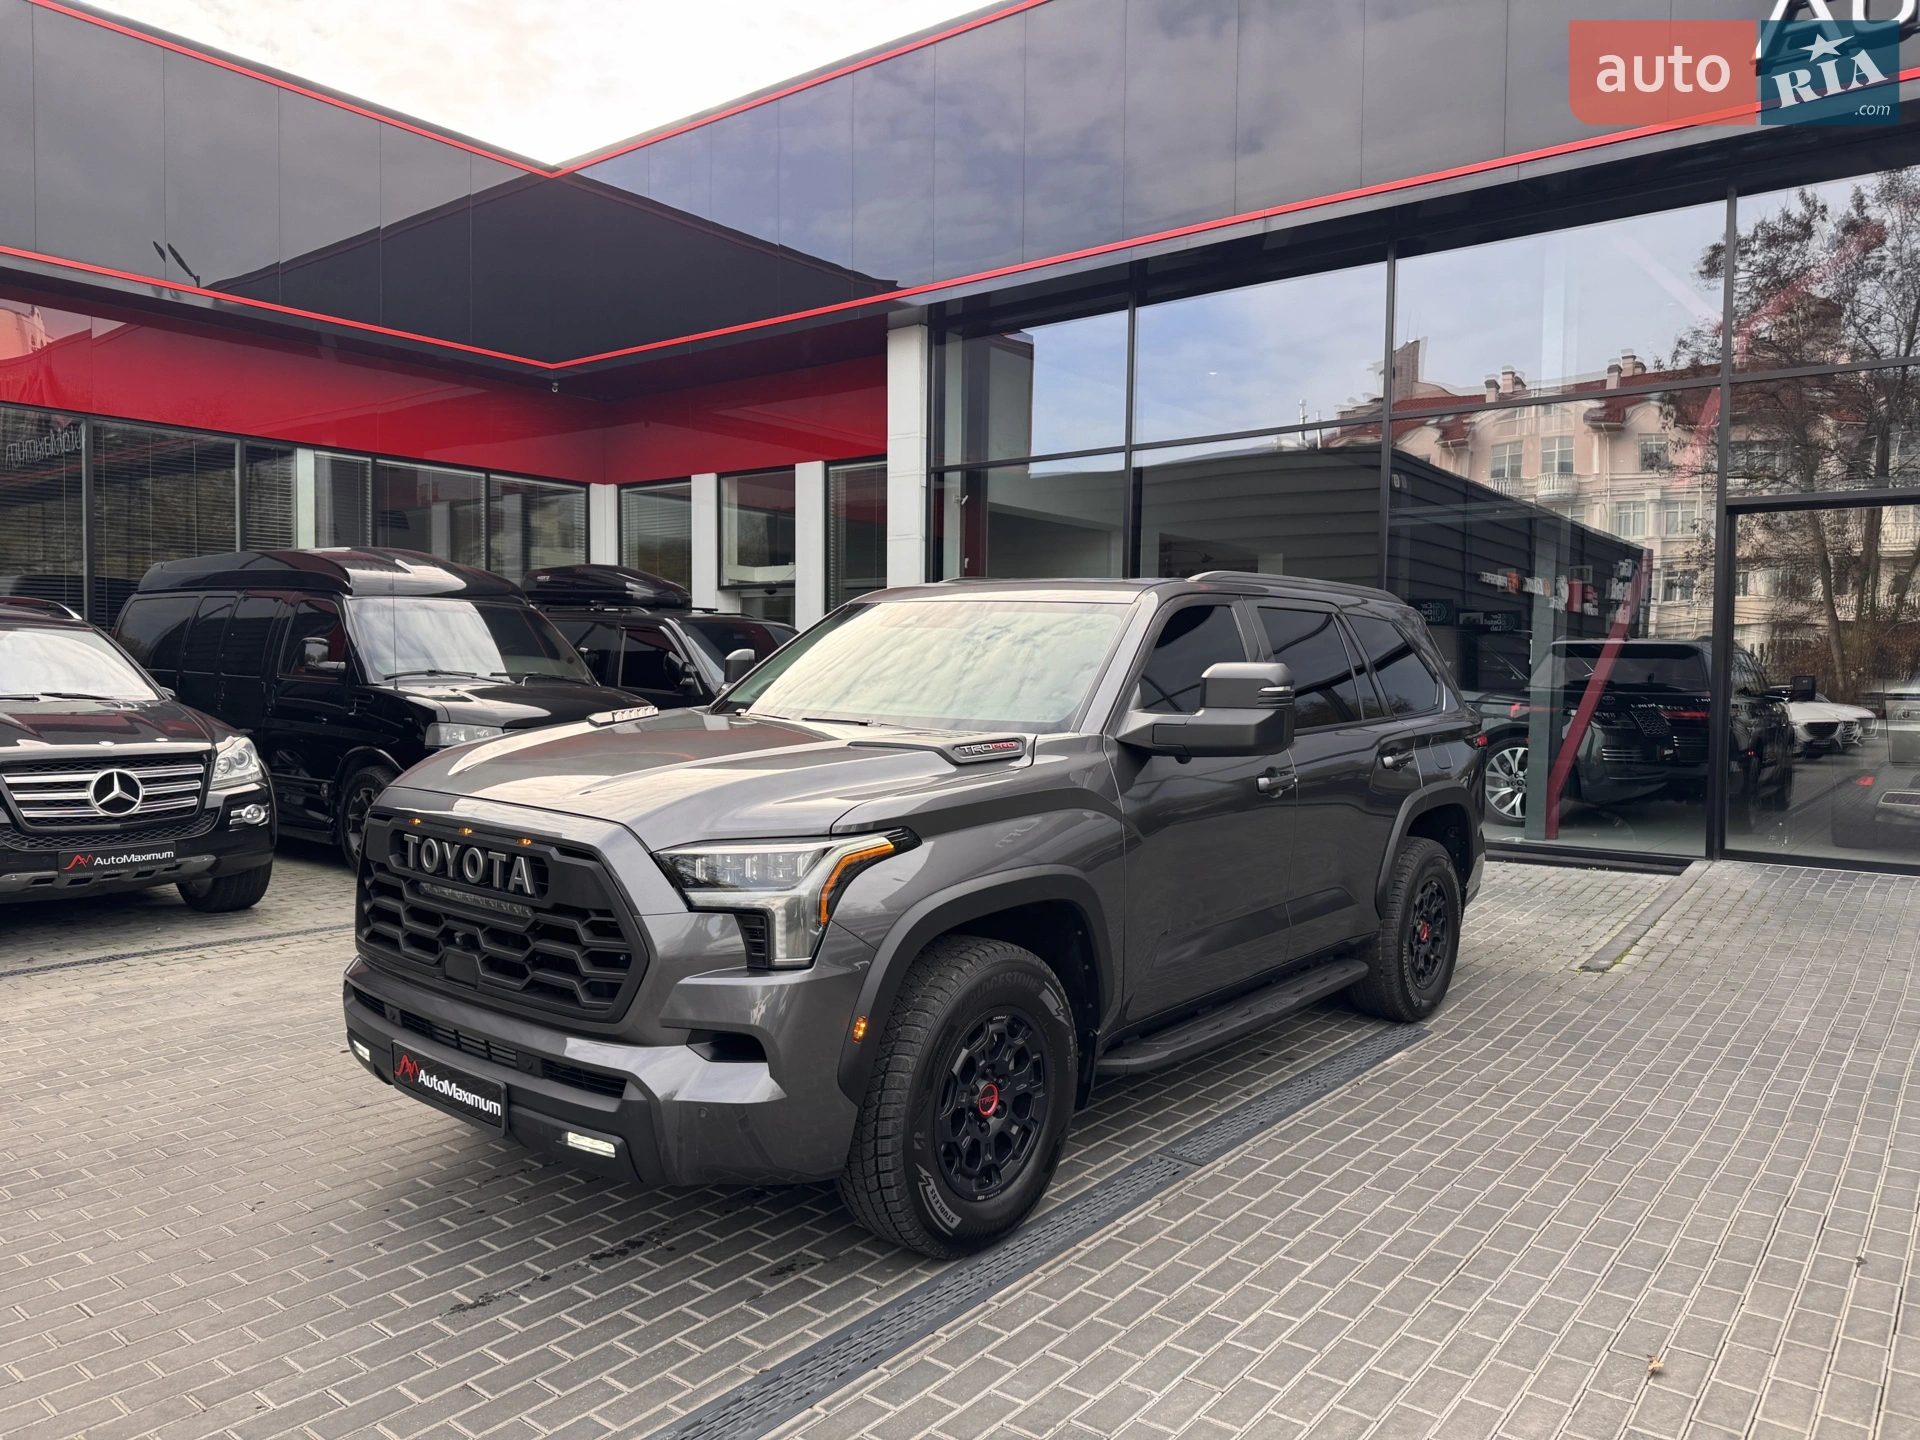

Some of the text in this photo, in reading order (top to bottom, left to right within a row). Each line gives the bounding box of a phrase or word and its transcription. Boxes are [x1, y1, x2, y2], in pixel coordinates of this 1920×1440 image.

[93, 850, 174, 866] AutoMaximum
[403, 833, 537, 898] TOYOTA
[417, 1069, 502, 1117] AutoMaximum
[929, 1188, 956, 1224] STUDLESS
